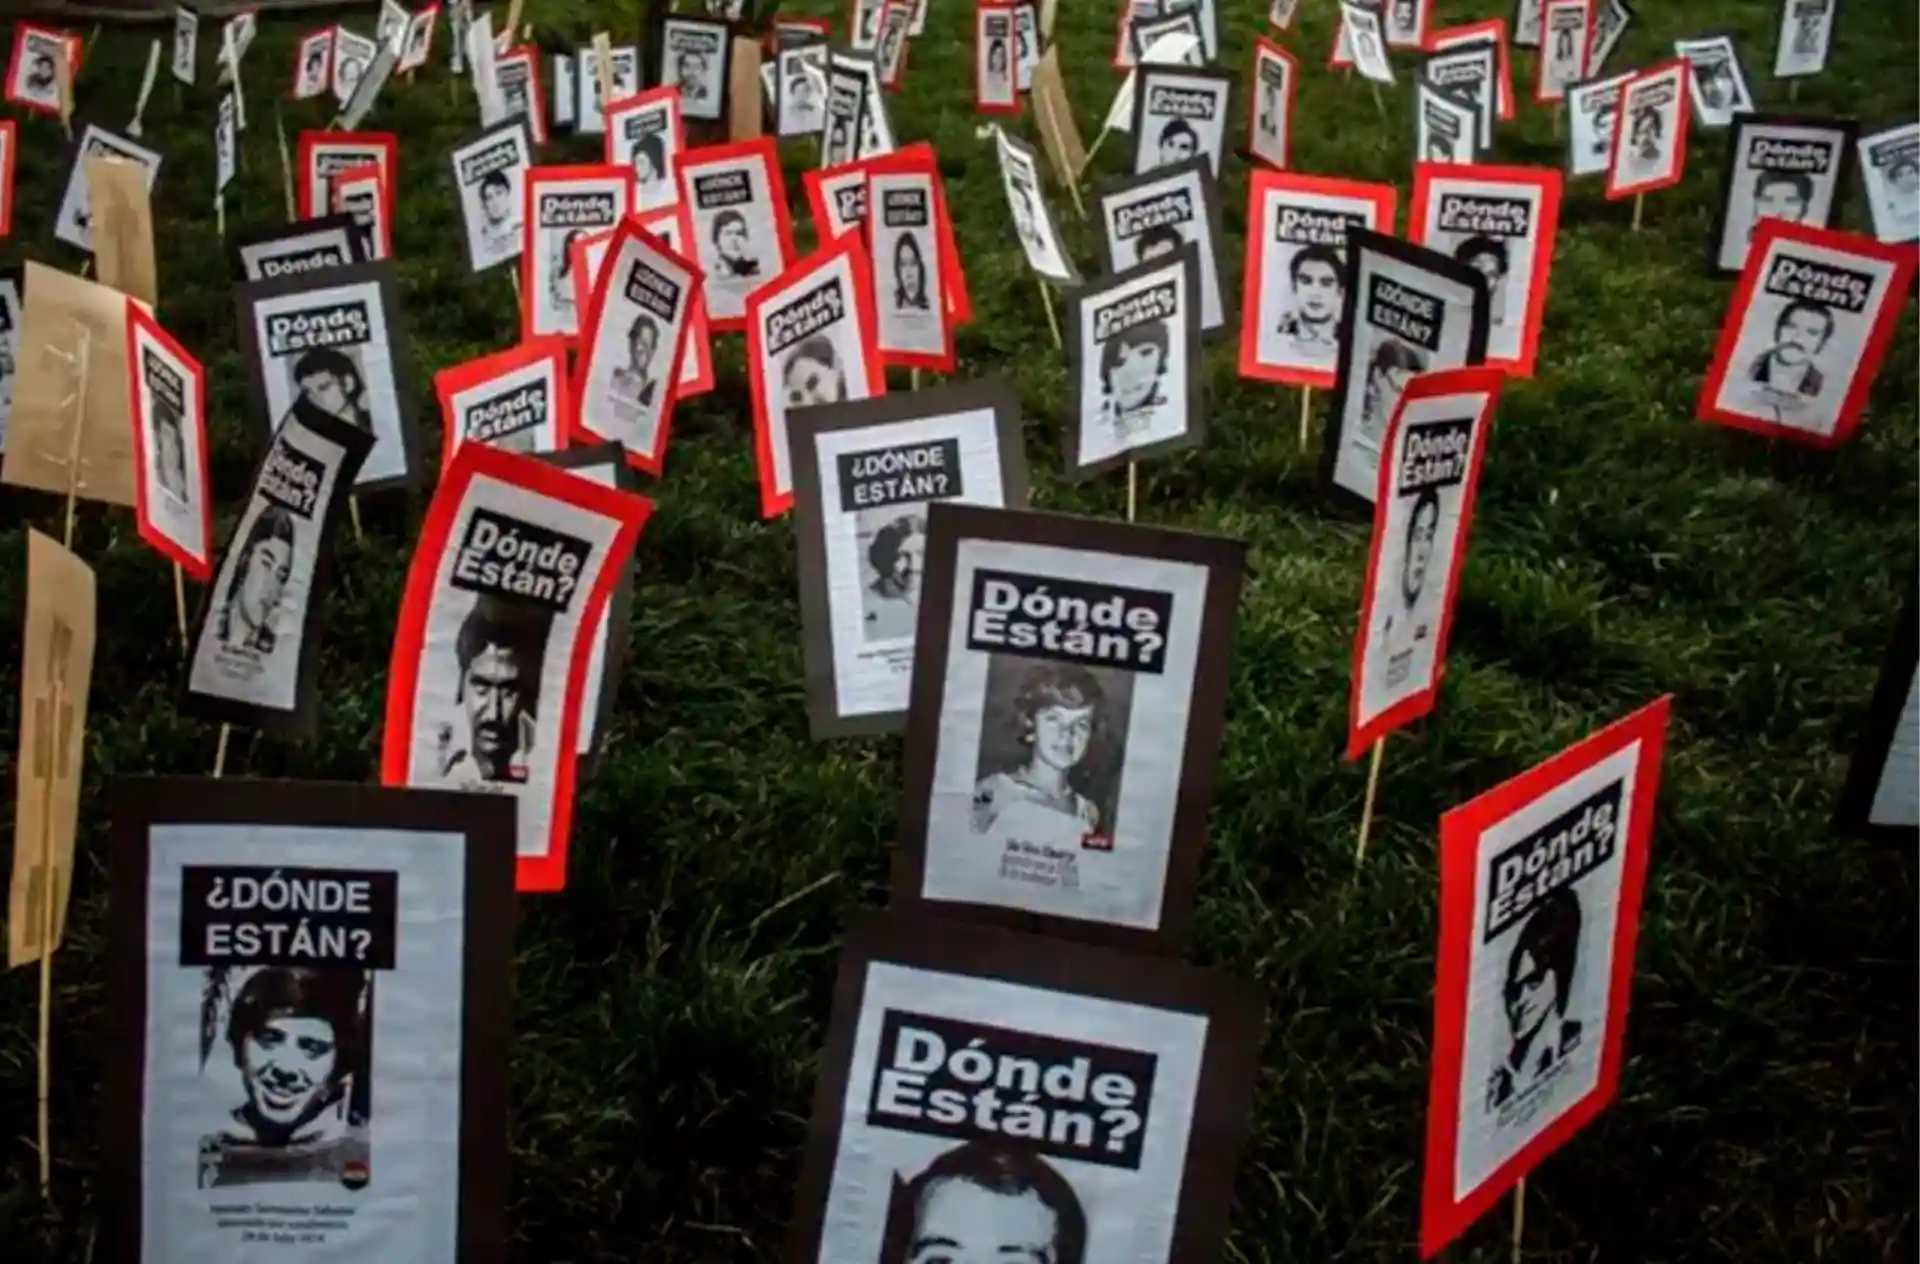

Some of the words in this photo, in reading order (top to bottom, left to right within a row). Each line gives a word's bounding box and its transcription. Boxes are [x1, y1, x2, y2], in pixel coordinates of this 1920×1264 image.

[272, 306, 363, 336] Dónde
[852, 446, 945, 479] ¿DÓNDE
[854, 472, 949, 505] ESTÁN?
[471, 519, 580, 574] Dónde
[457, 548, 576, 603] Están?
[984, 580, 1160, 632] Dónde
[973, 608, 1163, 663] Están?
[1499, 800, 1614, 894] Dónde
[206, 870, 371, 913] ¿DÓNDE
[206, 918, 372, 961] ESTÁN?
[893, 1025, 1137, 1107] Dónde
[875, 1068, 1142, 1152] Están?
